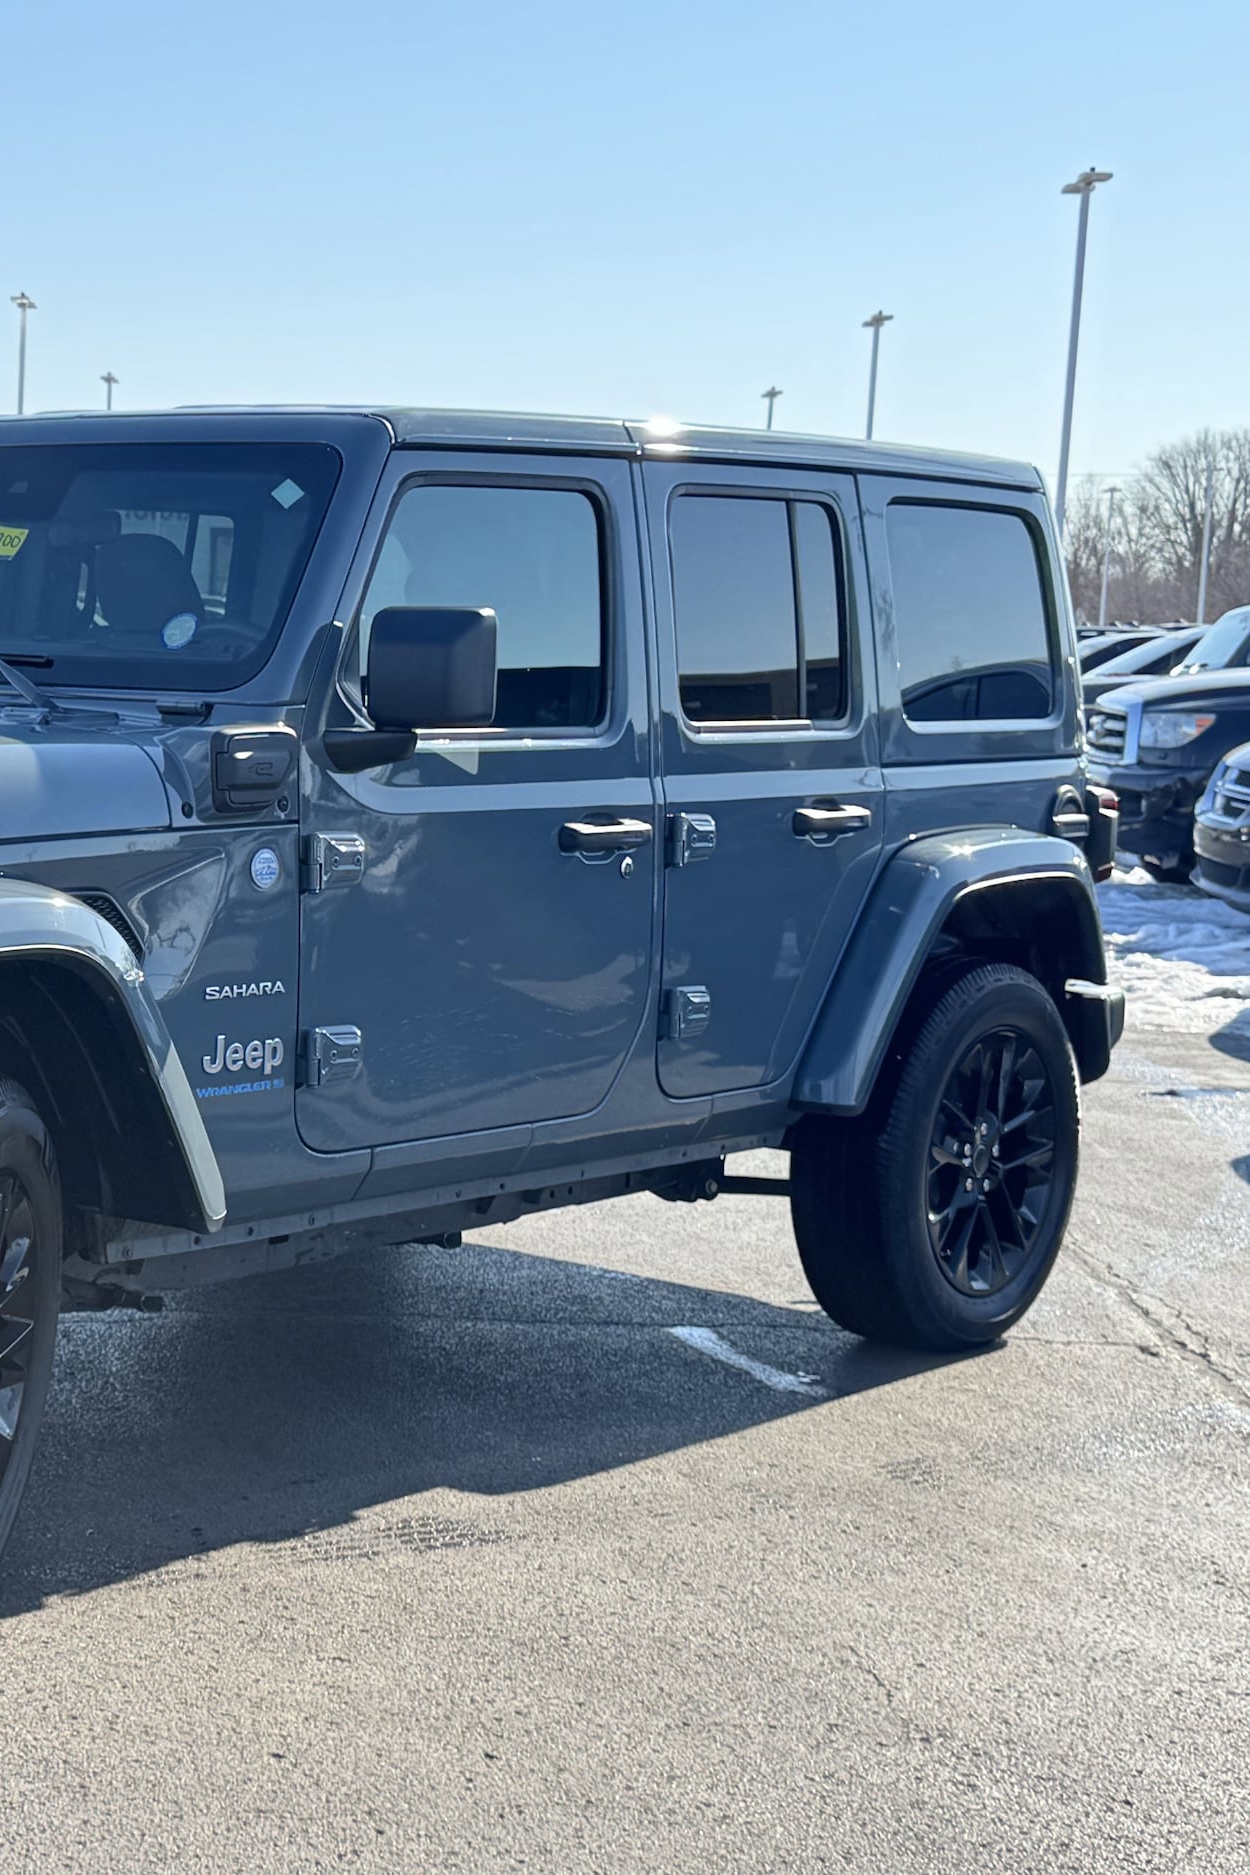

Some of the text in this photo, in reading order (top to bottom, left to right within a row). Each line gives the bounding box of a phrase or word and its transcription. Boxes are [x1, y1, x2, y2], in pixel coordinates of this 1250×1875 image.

[205, 981, 285, 1000] SAHARA
[202, 1035, 284, 1075] Jeep
[196, 1080, 271, 1098] WRANGLER
